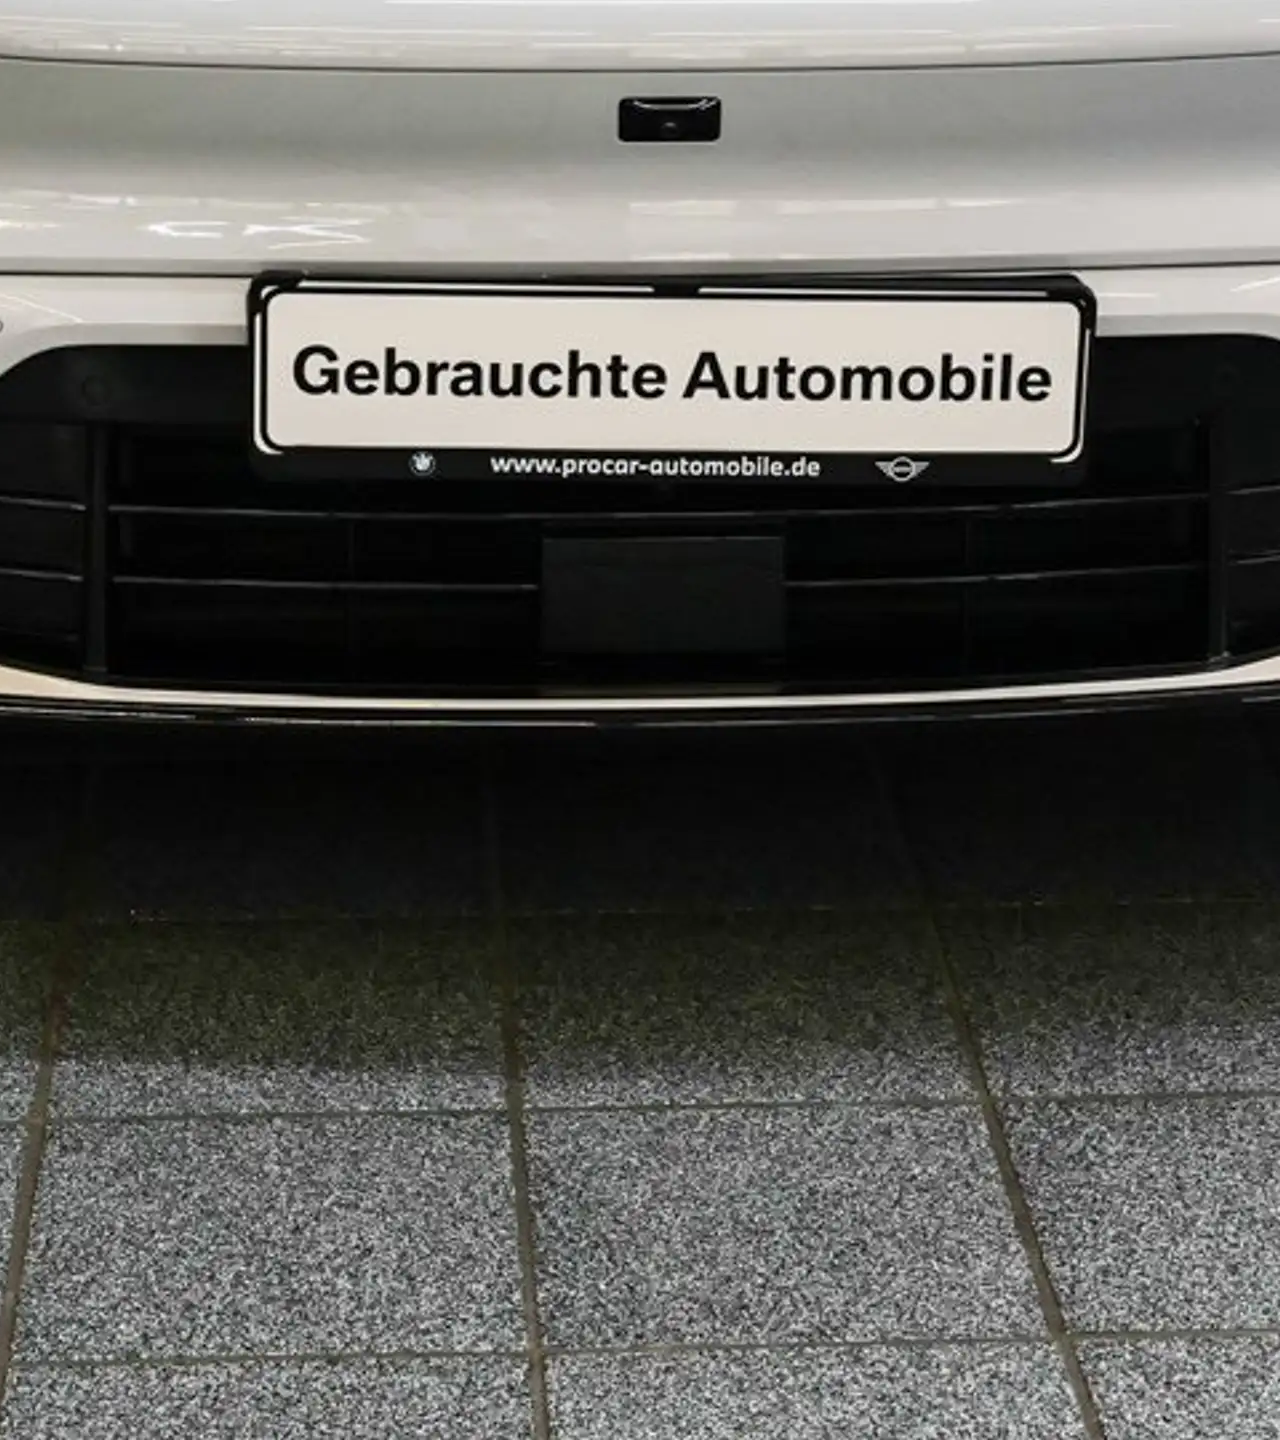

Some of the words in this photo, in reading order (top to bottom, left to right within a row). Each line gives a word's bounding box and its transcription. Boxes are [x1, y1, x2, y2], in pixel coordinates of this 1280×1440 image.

[292, 344, 668, 400] Gebrauchte
[681, 351, 1053, 402] Automobile
[489, 454, 822, 479] www.procar-automobile.de
